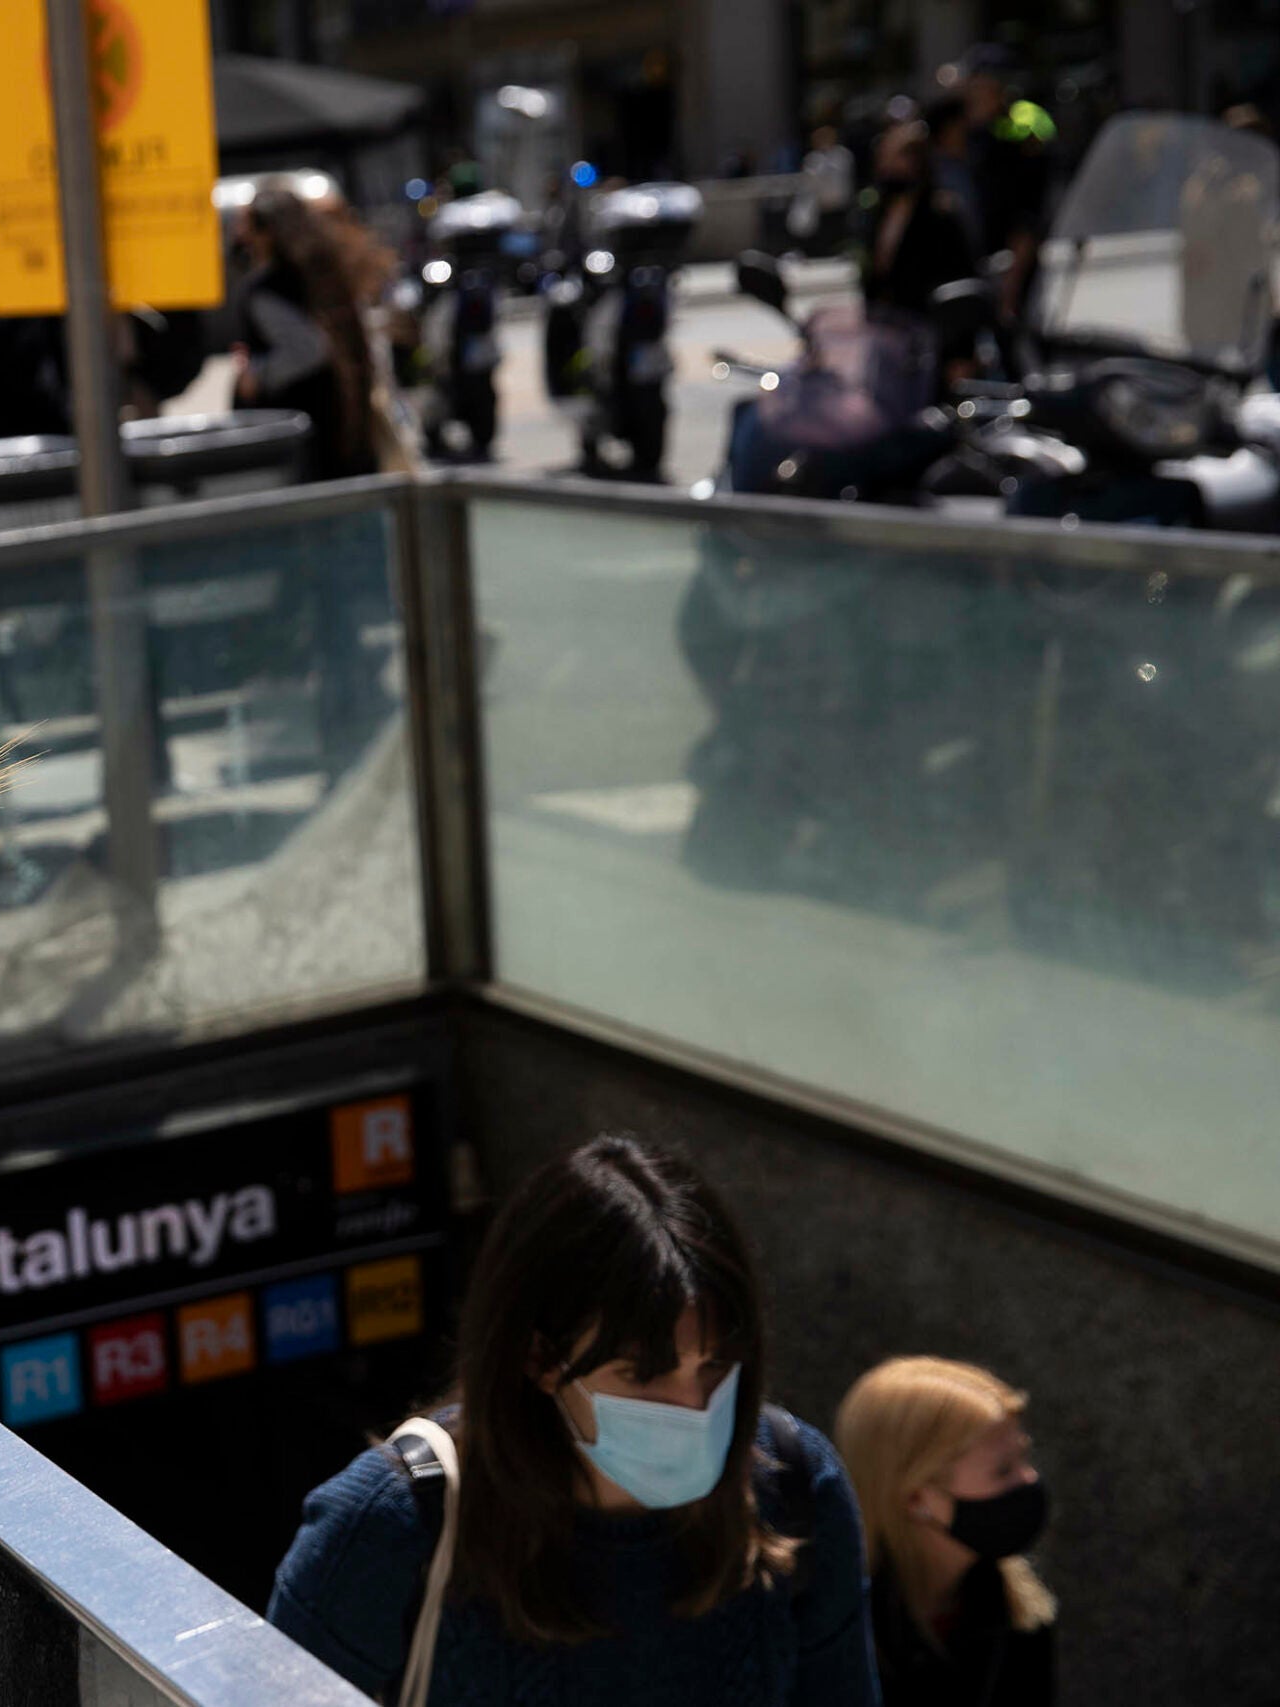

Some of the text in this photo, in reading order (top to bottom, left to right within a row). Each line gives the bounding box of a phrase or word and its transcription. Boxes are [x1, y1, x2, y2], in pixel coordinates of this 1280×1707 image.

[361, 1106, 410, 1164] R
[10, 1354, 71, 1410] R1
[93, 1334, 167, 1390] R3
[182, 1314, 250, 1368] R4
